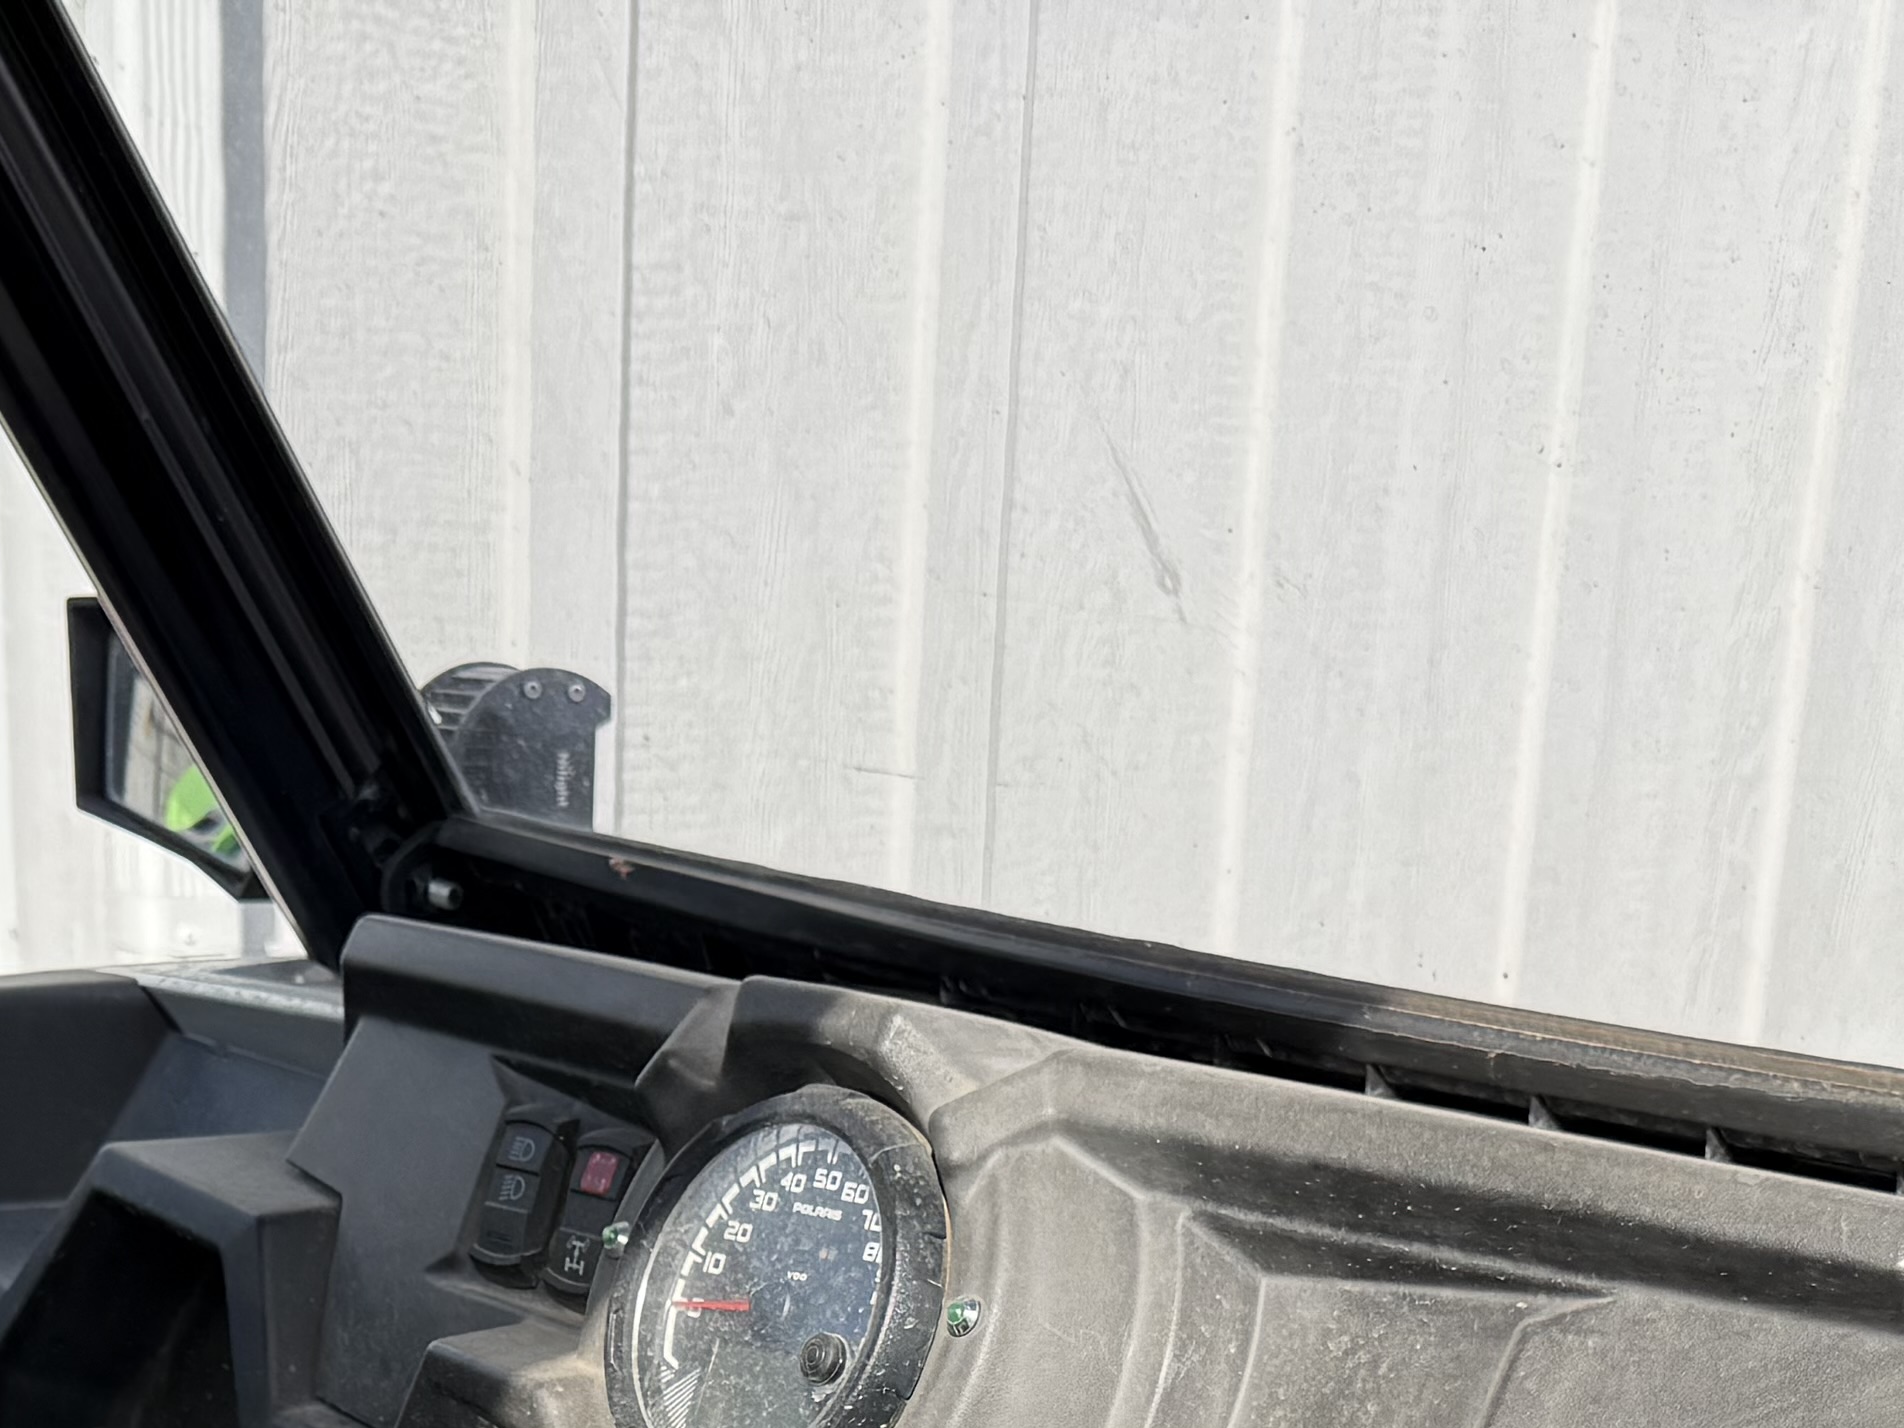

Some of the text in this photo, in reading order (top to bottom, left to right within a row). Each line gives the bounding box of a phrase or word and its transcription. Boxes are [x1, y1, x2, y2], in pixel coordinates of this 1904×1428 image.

[779, 1171, 808, 1194] 40
[812, 1167, 843, 1192] 50
[748, 1188, 779, 1213] 30
[840, 1180, 870, 1205] 60
[792, 1202, 843, 1221] POLARIS
[723, 1219, 754, 1244] 20
[702, 1251, 727, 1275] 10
